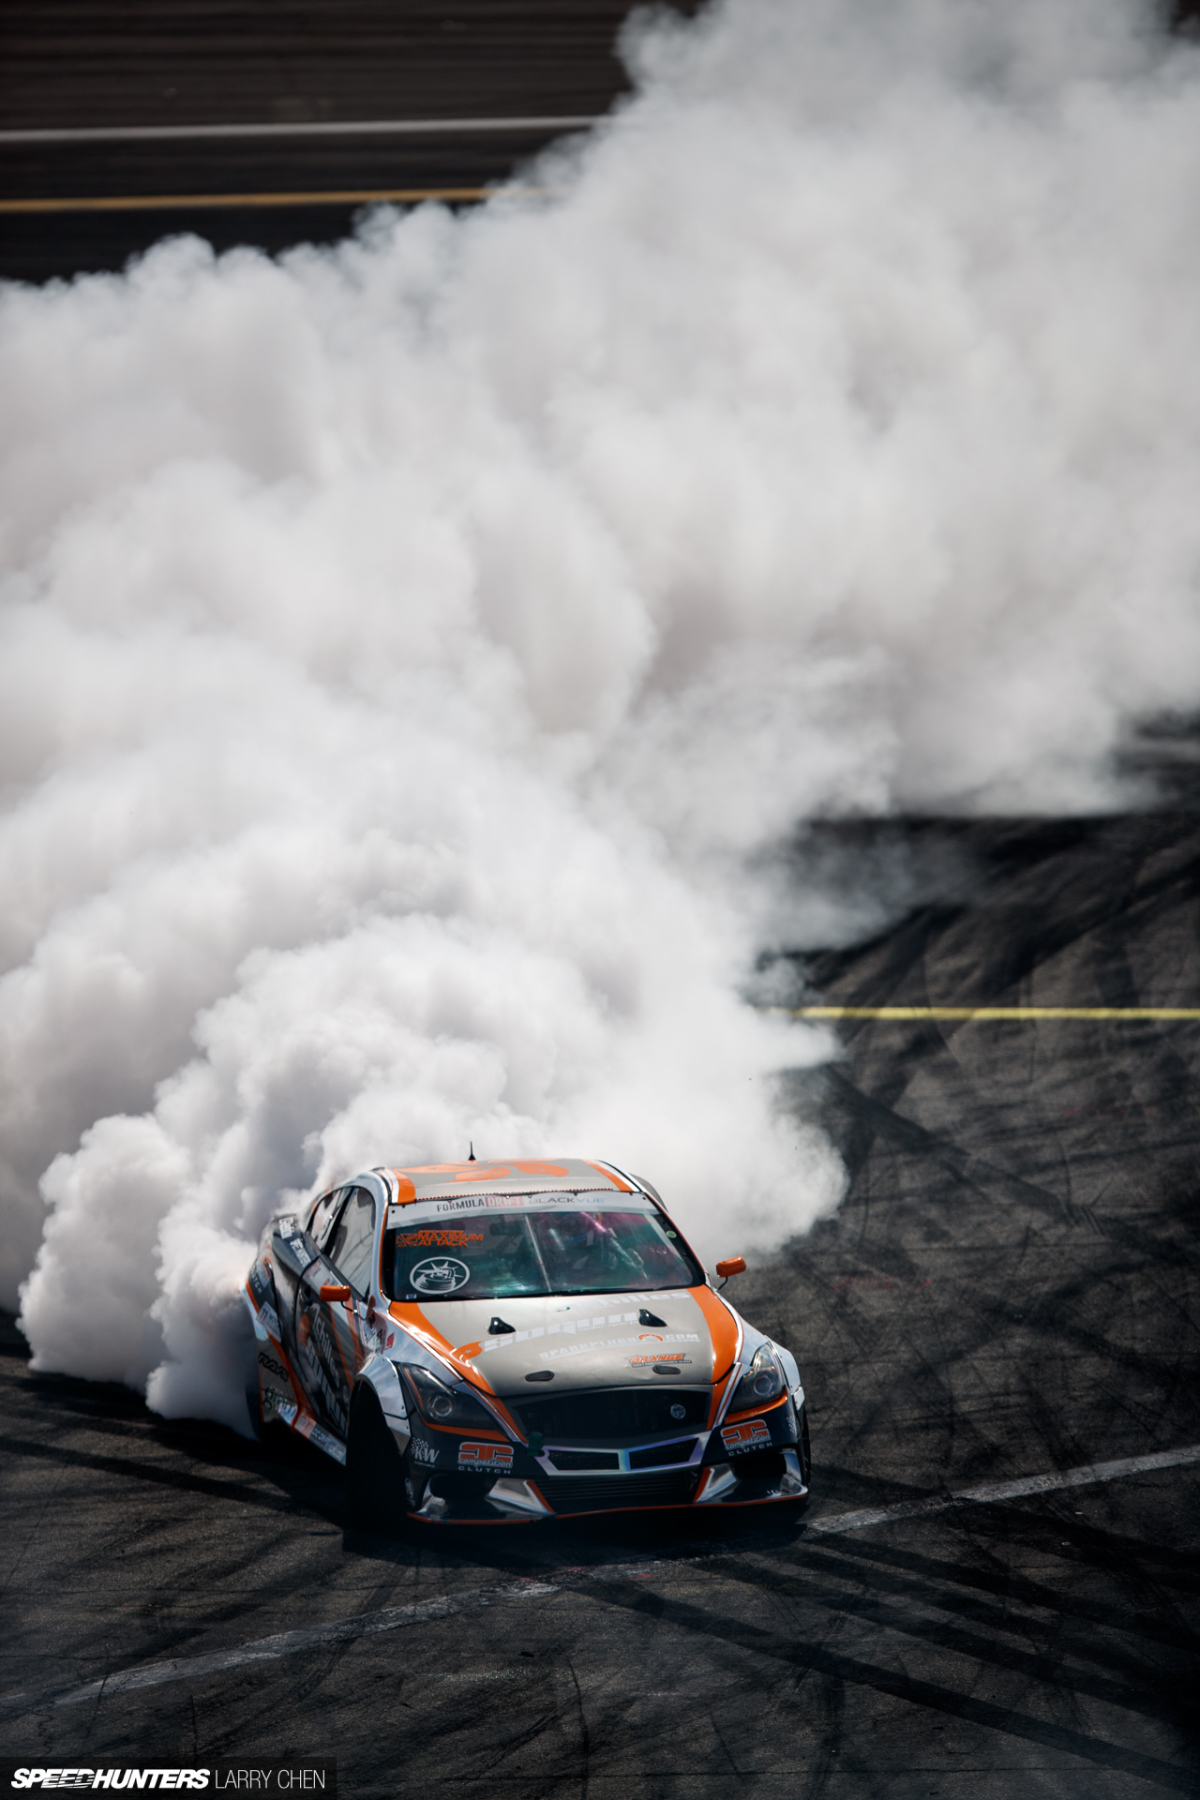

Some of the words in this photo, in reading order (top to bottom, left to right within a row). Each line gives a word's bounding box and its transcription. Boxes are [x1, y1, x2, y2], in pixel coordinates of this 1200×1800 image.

[436, 1198, 485, 1213] FORMULA
[529, 1196, 605, 1205] BLACKVUE
[418, 1229, 483, 1241] MAXIMUM
[418, 1239, 468, 1247] ATTACK
[630, 1353, 686, 1365] ORANGE
[725, 1434, 771, 1450] competition
[414, 1445, 440, 1464] KW
[728, 1442, 773, 1456] CLUTCH
[458, 1458, 513, 1469] competition
[458, 1466, 511, 1475] CLUTCH
